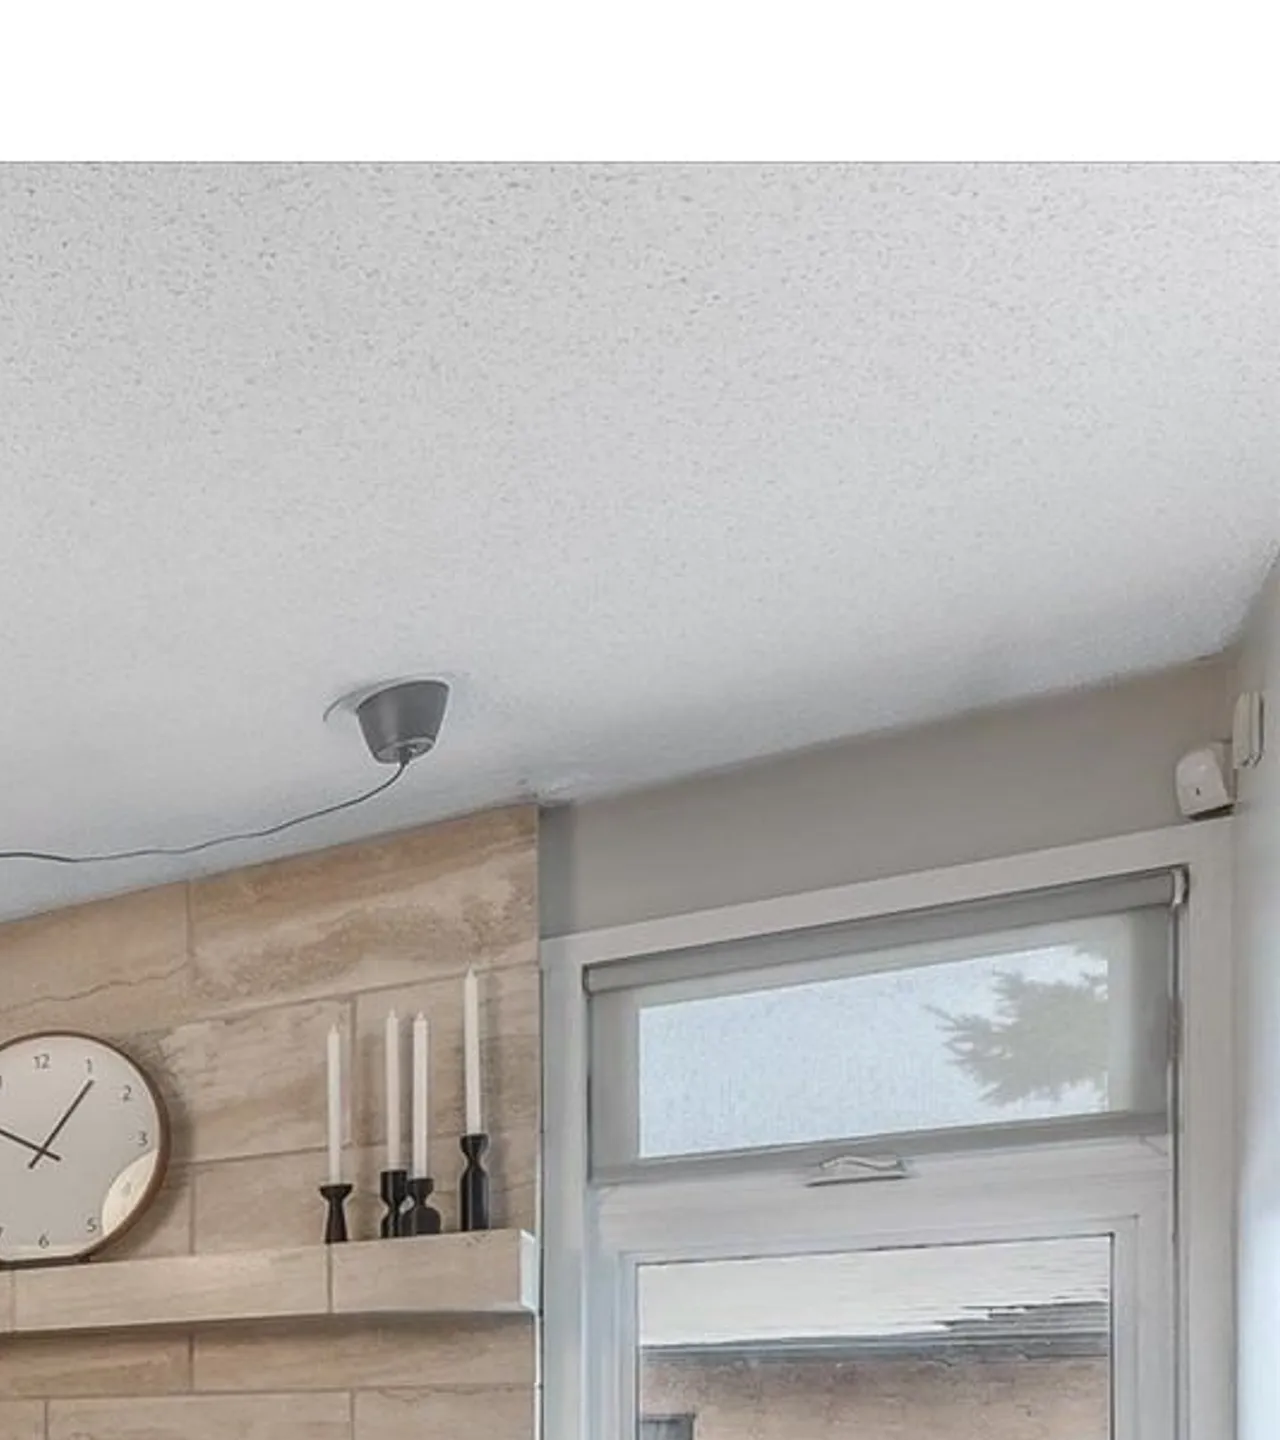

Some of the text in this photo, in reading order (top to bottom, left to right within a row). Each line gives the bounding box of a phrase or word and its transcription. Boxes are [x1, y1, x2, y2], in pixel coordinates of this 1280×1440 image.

[34, 1055, 50, 1069] 12
[122, 1085, 132, 1102] 2
[139, 1132, 148, 1147] 3
[87, 1218, 97, 1232] 5
[39, 1235, 49, 1248] 6
